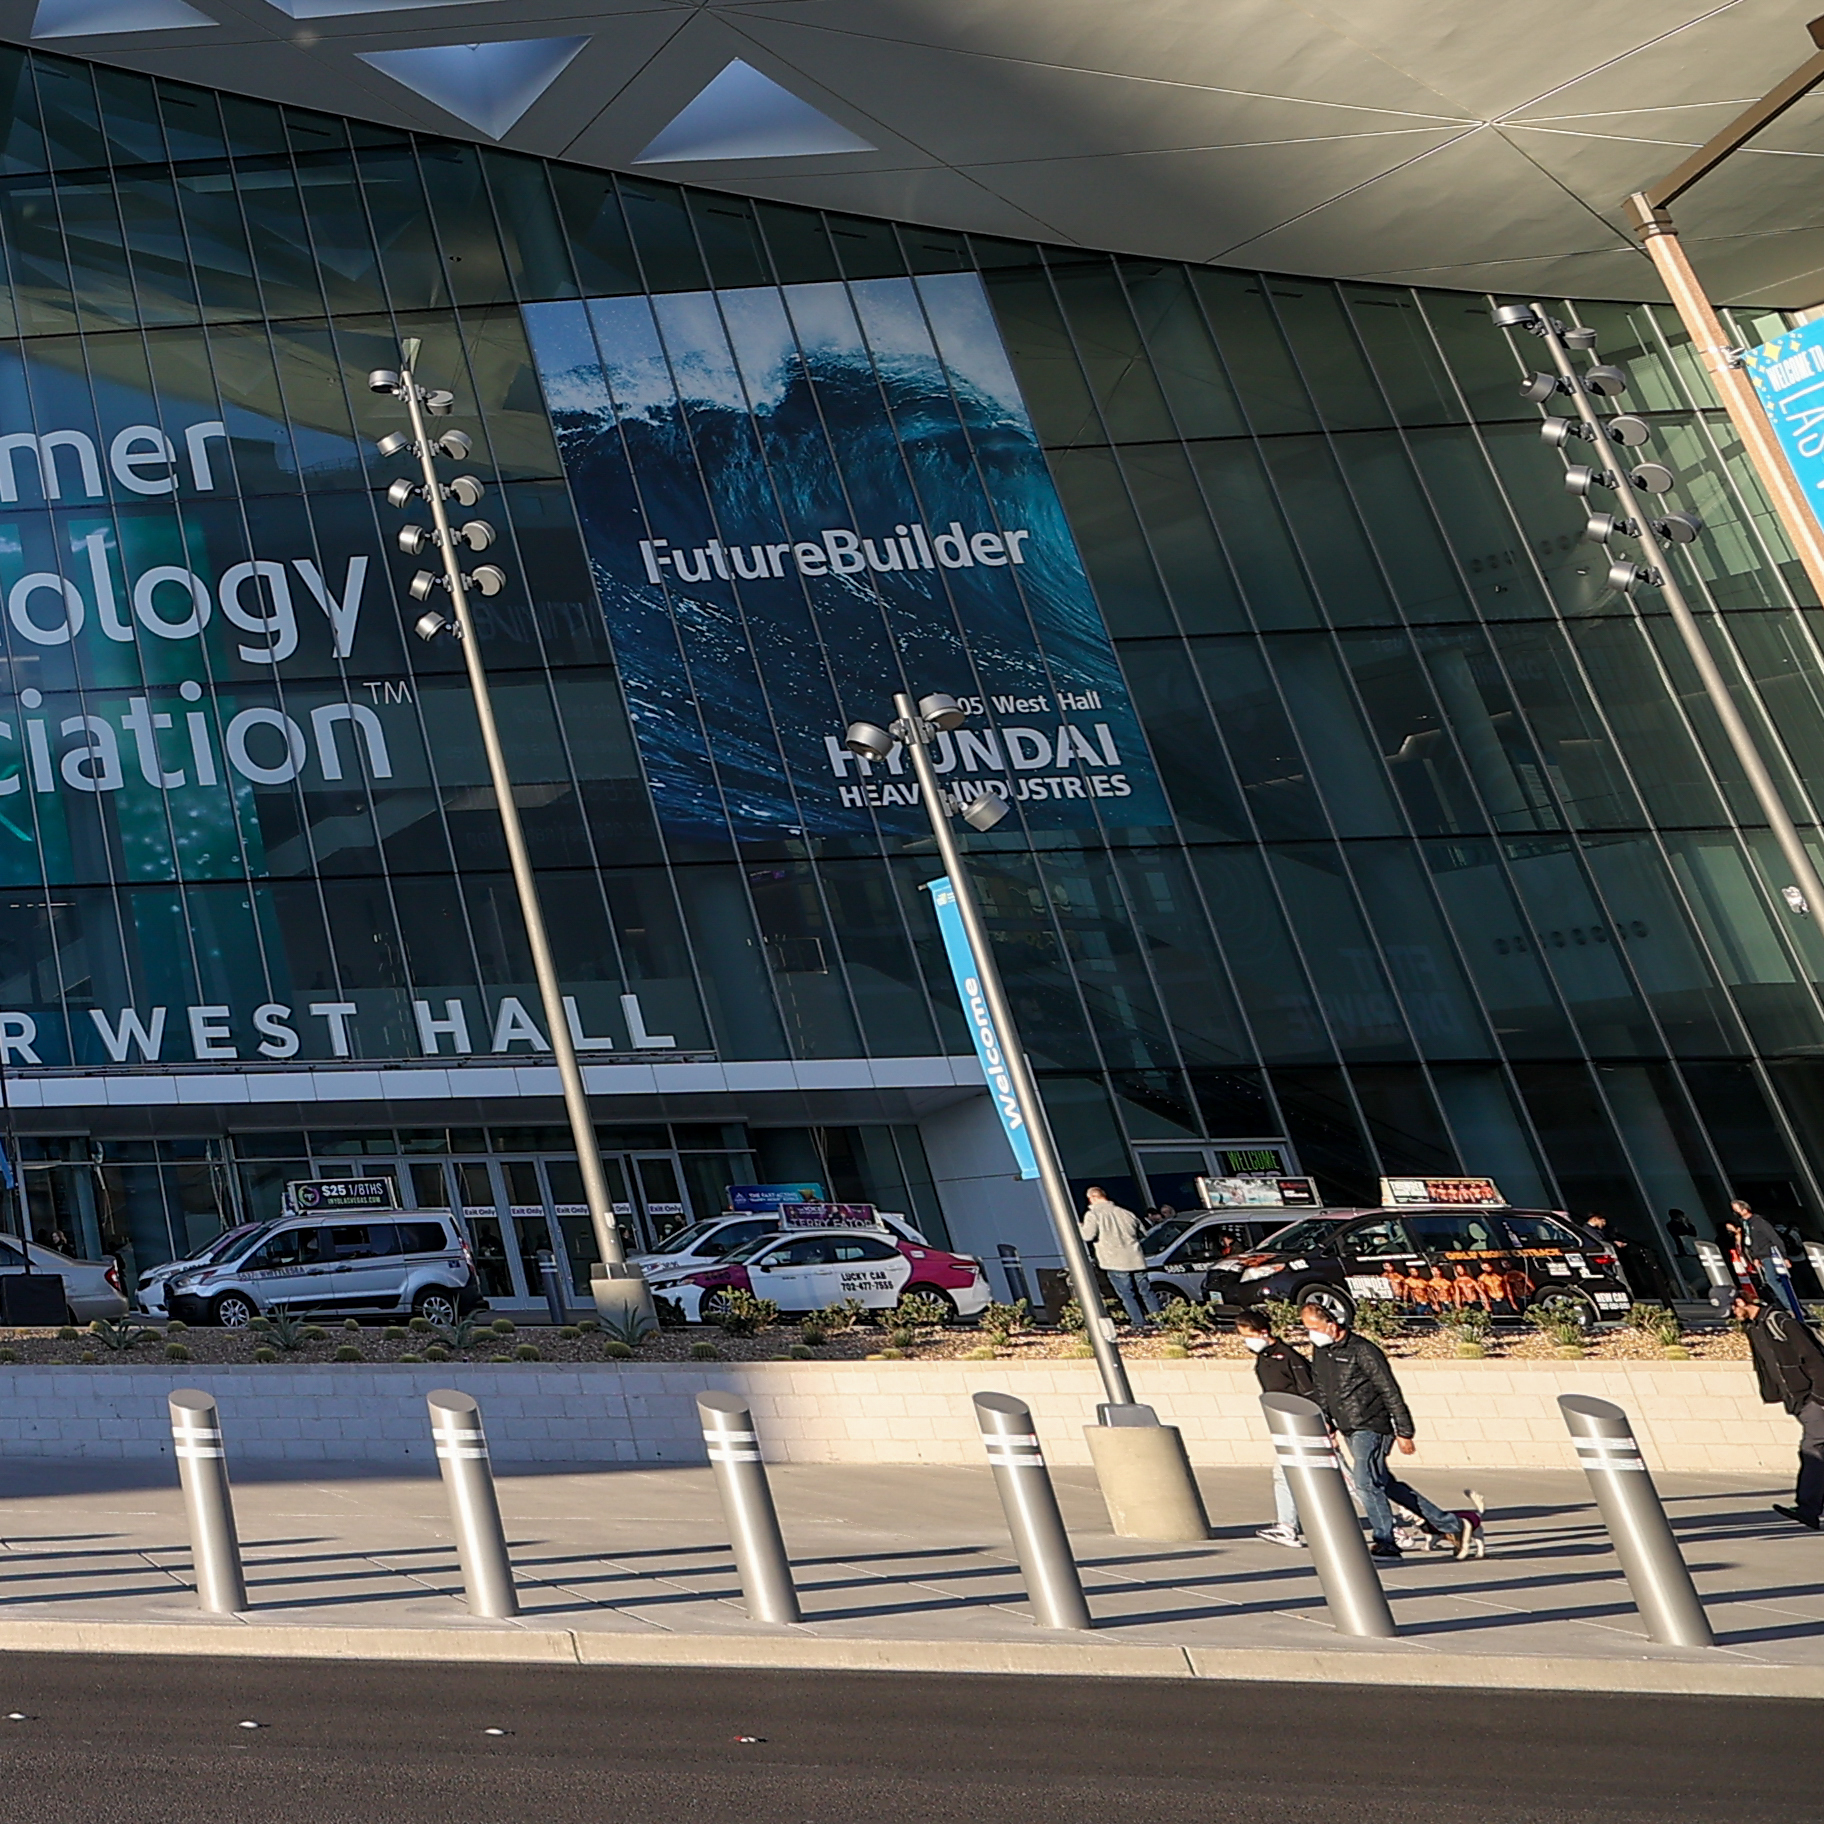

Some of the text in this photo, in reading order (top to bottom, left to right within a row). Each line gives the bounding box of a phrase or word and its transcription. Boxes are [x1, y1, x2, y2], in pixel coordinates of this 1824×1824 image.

[1766, 350, 1815, 393] WELCOME
[638, 521, 1029, 585] FutureBuilder
[992, 691, 1050, 716] West
[1058, 689, 1102, 714] Hall
[837, 781, 919, 810] HEAV
[89, 1001, 358, 1063] WEST
[413, 993, 677, 1056] HALL
[964, 977, 1024, 1130] Welcome
[1226, 1150, 1281, 1172] WELCOME
[321, 1184, 347, 1197] $25
[481, 1208, 496, 1216] Only
[527, 1207, 544, 1216] Only
[571, 1206, 588, 1215] Only
[665, 1205, 682, 1214] Only
[841, 1272, 887, 1281] LUCKY CAB
